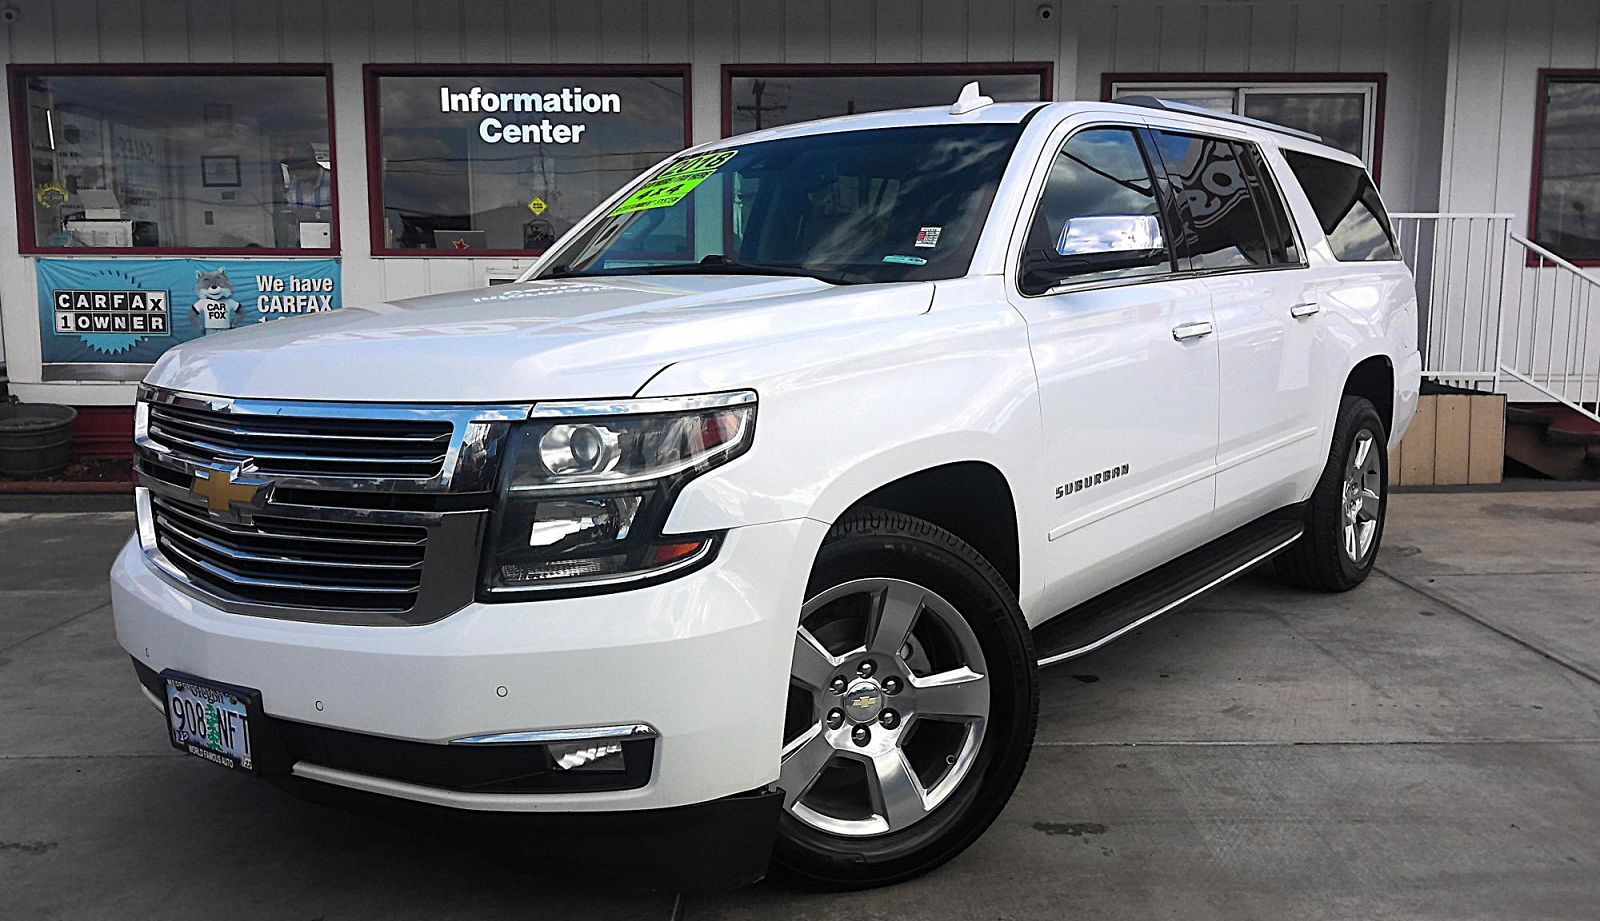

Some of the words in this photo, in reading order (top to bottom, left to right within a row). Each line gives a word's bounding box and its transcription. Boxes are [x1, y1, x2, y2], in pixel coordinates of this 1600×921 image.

[440, 87, 621, 112] Information
[479, 117, 586, 143] Center
[256, 275, 284, 292] We
[290, 275, 333, 292] have
[58, 294, 163, 311] CARFAX
[206, 303, 227, 311] CAR
[257, 295, 332, 313] CARFAX
[61, 315, 71, 329] 1
[77, 316, 164, 330] OWNER
[208, 311, 227, 320] FOX
[1055, 463, 1130, 500] SUBURBAN
[173, 697, 206, 738] 908
[216, 706, 249, 755] NFT
[188, 744, 203, 758] WORLD
[203, 750, 221, 764] FAMOUS
[222, 757, 234, 769] AUTO
